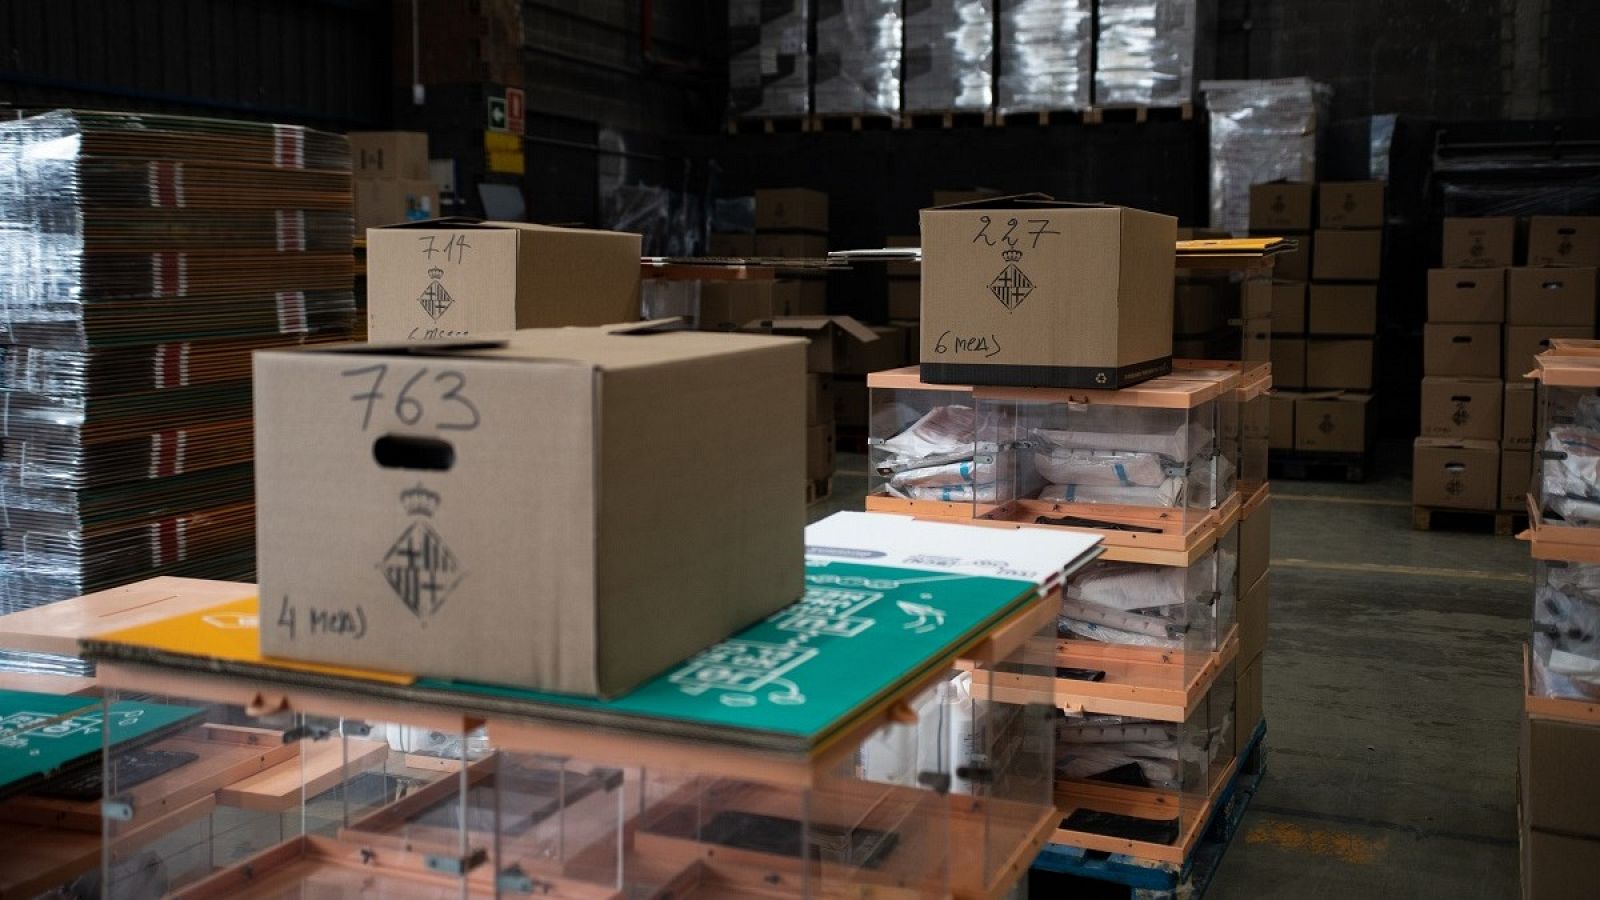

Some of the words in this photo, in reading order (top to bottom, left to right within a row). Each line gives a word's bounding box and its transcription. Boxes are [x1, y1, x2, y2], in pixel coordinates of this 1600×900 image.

[972, 215, 1061, 248] 227
[417, 233, 472, 264] 714
[934, 330, 951, 354] 6
[341, 363, 481, 431] 763
[277, 594, 296, 640] 4
